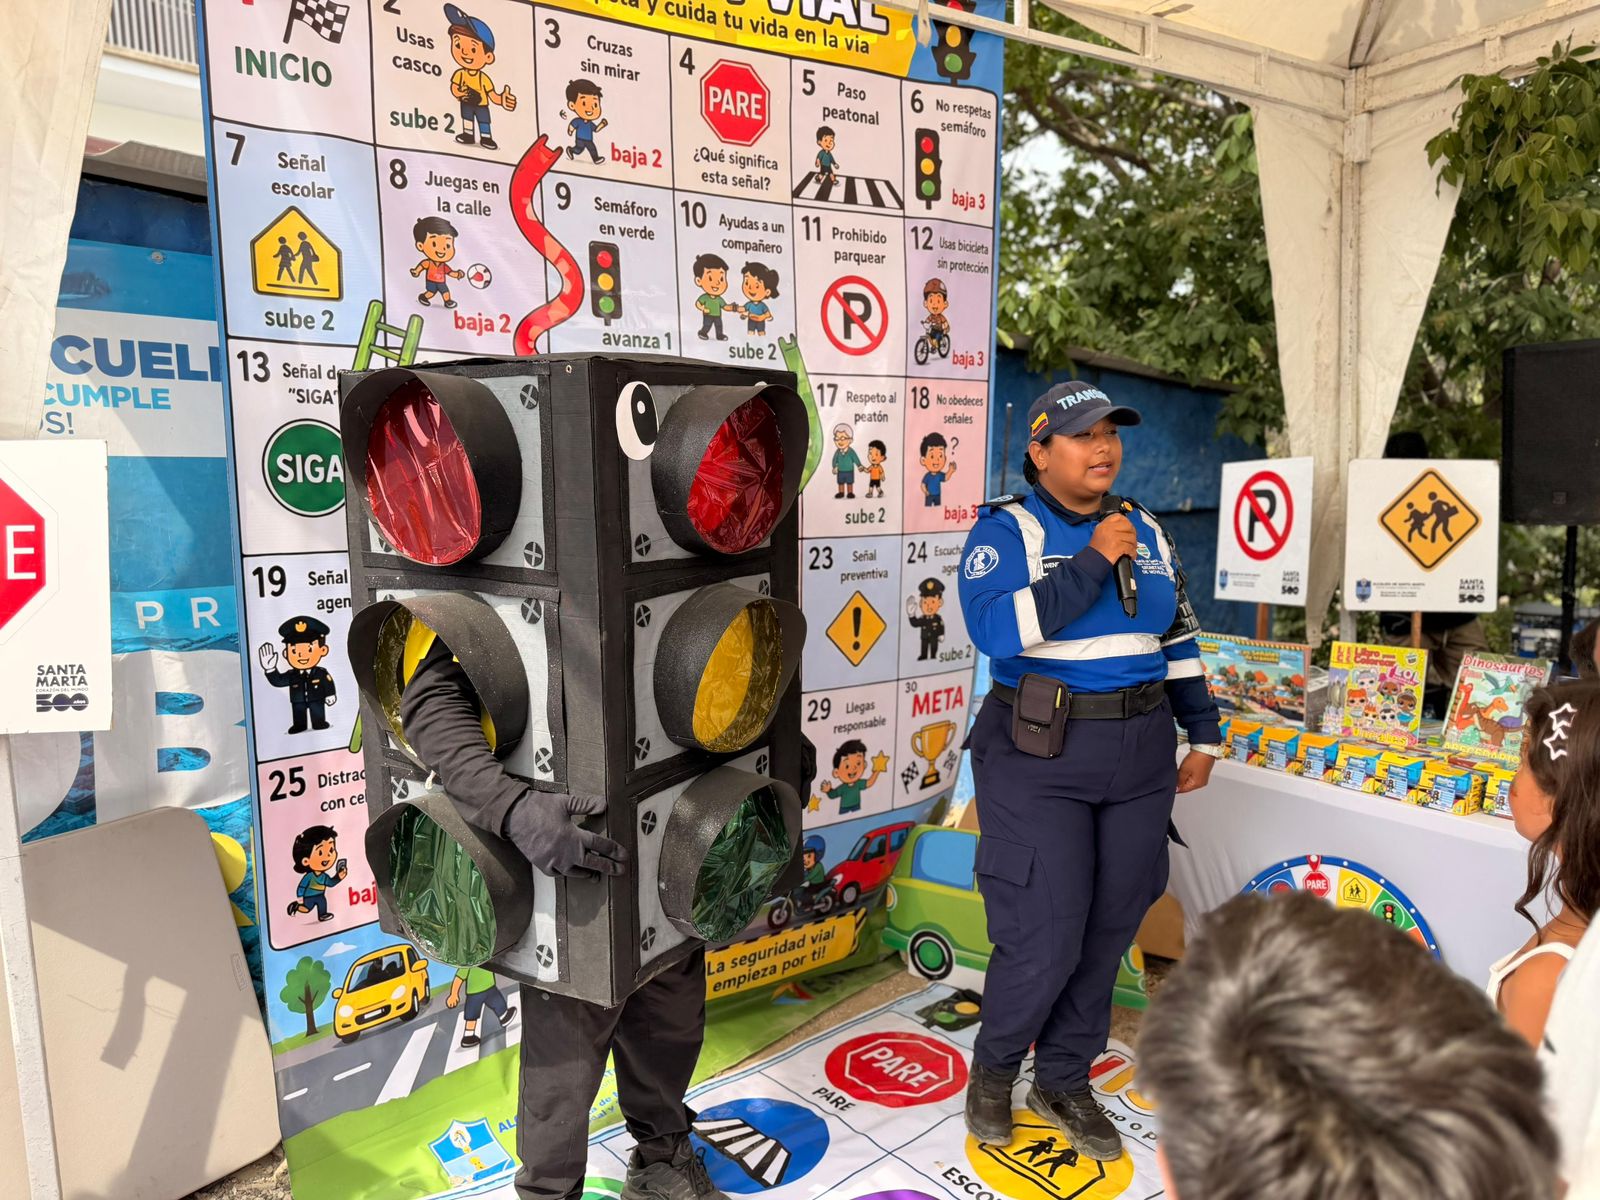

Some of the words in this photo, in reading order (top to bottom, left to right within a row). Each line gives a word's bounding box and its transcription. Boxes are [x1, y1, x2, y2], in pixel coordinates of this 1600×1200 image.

[396, 26, 435, 51] Usas
[544, 18, 561, 49] 3
[664, 0, 717, 25] cuida
[724, 11, 744, 31] tu
[750, 16, 789, 40] vida
[795, 26, 817, 45] en
[823, 28, 839, 49] la
[845, 36, 870, 55] via
[587, 34, 633, 58] Cruzas
[234, 46, 332, 88] INICIO
[392, 54, 443, 78] casco
[580, 58, 601, 76] sin
[604, 64, 640, 83] mirar
[679, 47, 695, 76] 4
[802, 70, 816, 96] 5
[837, 82, 867, 102] Paso
[708, 86, 763, 121] PARE
[910, 89, 924, 114] 6
[936, 98, 950, 113] No
[953, 102, 992, 122] respetas
[389, 108, 439, 132] sube
[443, 113, 457, 135] 2
[822, 103, 880, 127] peatonal
[940, 118, 987, 139] semáforo
[225, 131, 246, 166] 7
[610, 143, 648, 170] baja
[652, 149, 663, 169] 2
[693, 146, 725, 166] ¿Qué
[728, 149, 779, 172] significa
[277, 151, 326, 173] Señal
[389, 158, 408, 190] 8
[425, 170, 479, 195] Juegas
[483, 180, 500, 195] en
[701, 170, 728, 189] esta
[731, 173, 771, 192] señal?
[271, 179, 335, 200] escolar
[555, 181, 572, 211] 9
[952, 188, 976, 210] baja
[978, 193, 986, 210] 3
[437, 196, 451, 213] la
[456, 198, 492, 218] calle
[594, 196, 658, 219] Semáforo
[680, 200, 707, 229] 10
[599, 222, 616, 237] en
[618, 222, 655, 242] verde
[718, 213, 760, 235] Ayudas
[762, 219, 770, 232] a
[772, 221, 785, 235] un
[801, 215, 822, 242] 11
[832, 226, 888, 245] Prohibido
[721, 237, 783, 256] compañero
[910, 226, 934, 251] 12
[939, 236, 957, 251] Usas
[958, 238, 989, 256] bicicleta
[834, 248, 886, 267] parquear
[937, 258, 948, 270] sin
[949, 257, 989, 276] protección
[264, 308, 316, 331] sube
[322, 309, 335, 331] 2
[454, 309, 495, 336] baja
[499, 314, 511, 334] 2
[602, 332, 660, 350] avanza
[665, 332, 673, 351] 1
[728, 341, 764, 360] sube
[767, 345, 777, 360] 2
[236, 350, 271, 383] 13
[282, 362, 322, 380] Señal
[327, 365, 338, 380] d
[952, 352, 975, 370] baja
[977, 351, 984, 366] 3
[817, 383, 838, 407] 17
[846, 391, 887, 407] Respeto
[889, 392, 897, 403] al
[911, 386, 930, 409] 18
[936, 394, 948, 406] No
[949, 395, 984, 407] obedeces
[40, 411, 74, 435] S!
[854, 410, 888, 425] peatón
[943, 413, 973, 425] señales
[276, 453, 344, 484] SIGA
[845, 509, 876, 525] sube
[878, 507, 885, 523] 2
[944, 507, 968, 524] baja
[971, 504, 977, 519] 3
[809, 546, 833, 570] 23
[852, 550, 877, 562] Señal
[907, 541, 927, 564] 24
[252, 565, 286, 598] 19
[308, 569, 348, 586] Señal
[840, 568, 888, 584] preventiva
[317, 597, 351, 614] agen
[939, 646, 963, 662] sube
[965, 645, 971, 657] 2
[36, 675, 88, 687] MARTA
[37, 664, 86, 676] SANTA
[905, 681, 917, 693] 30
[807, 698, 831, 722] 29
[846, 700, 875, 715] Llegas
[911, 686, 964, 717] META
[833, 716, 887, 734] responsable
[268, 766, 306, 802] 25
[318, 769, 366, 789] Distrac
[320, 798, 346, 813] con
[350, 789, 367, 806] ce
[348, 881, 377, 906] baj
[1306, 879, 1327, 890] PARE
[707, 960, 725, 976] La
[730, 937, 806, 967] seguridad
[811, 926, 836, 945] vial
[712, 965, 777, 993] empieza
[781, 955, 807, 977] por
[811, 946, 826, 962] ti!
[860, 1045, 942, 1089] PARE
[811, 1086, 857, 1112] PARE
[1097, 1100, 1126, 1122] ano
[942, 1167, 1002, 1200] ESCO
